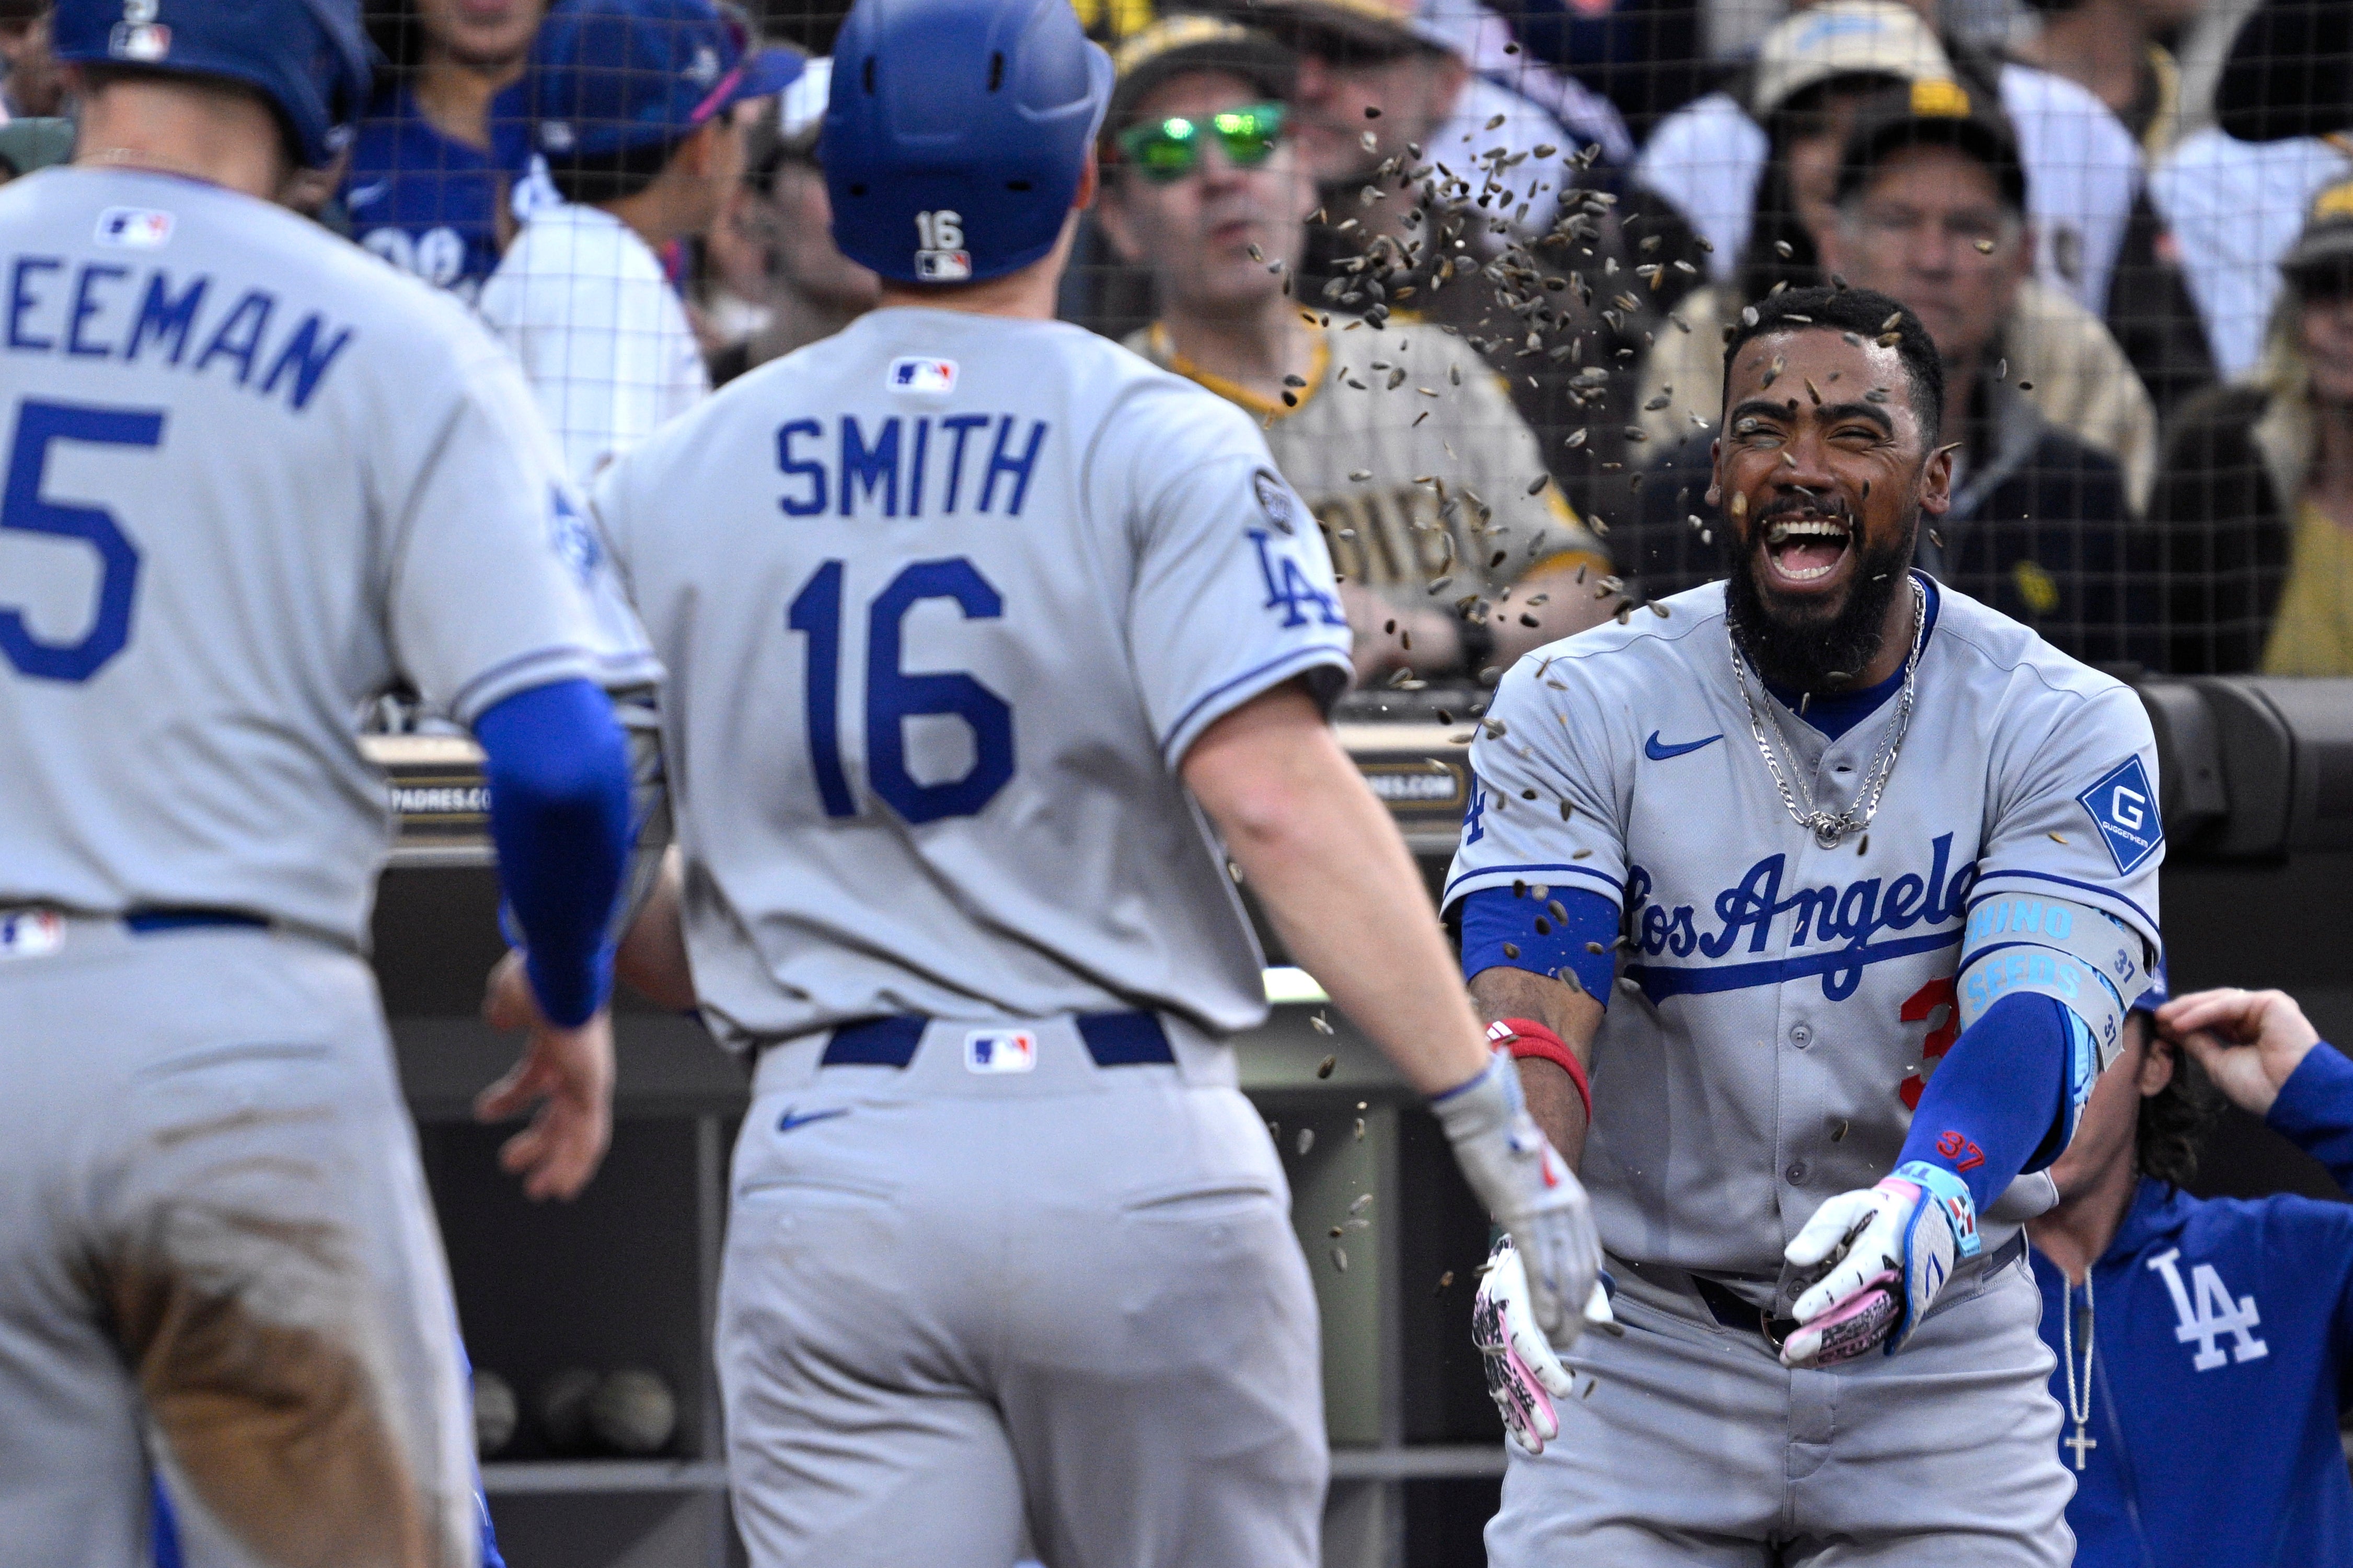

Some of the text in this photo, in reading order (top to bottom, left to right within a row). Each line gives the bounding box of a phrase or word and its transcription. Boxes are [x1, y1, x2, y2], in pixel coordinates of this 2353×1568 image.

[916, 210, 964, 250] 16
[6, 253, 353, 411] EEMAN
[777, 413, 1048, 517] SMITH
[0, 398, 166, 683] 5
[1247, 528, 1349, 628] LA
[788, 556, 1014, 824] 16
[2103, 821, 2148, 849] GUGGENHEIM
[2112, 785, 2146, 830] G
[1622, 865, 1698, 958] Los
[1967, 955, 2082, 1012] SEEDS
[2115, 949, 2135, 984] 37
[2104, 1014, 2117, 1048] 37
[1936, 1130, 1985, 1173] 37
[2147, 1248, 2269, 1372] LA
